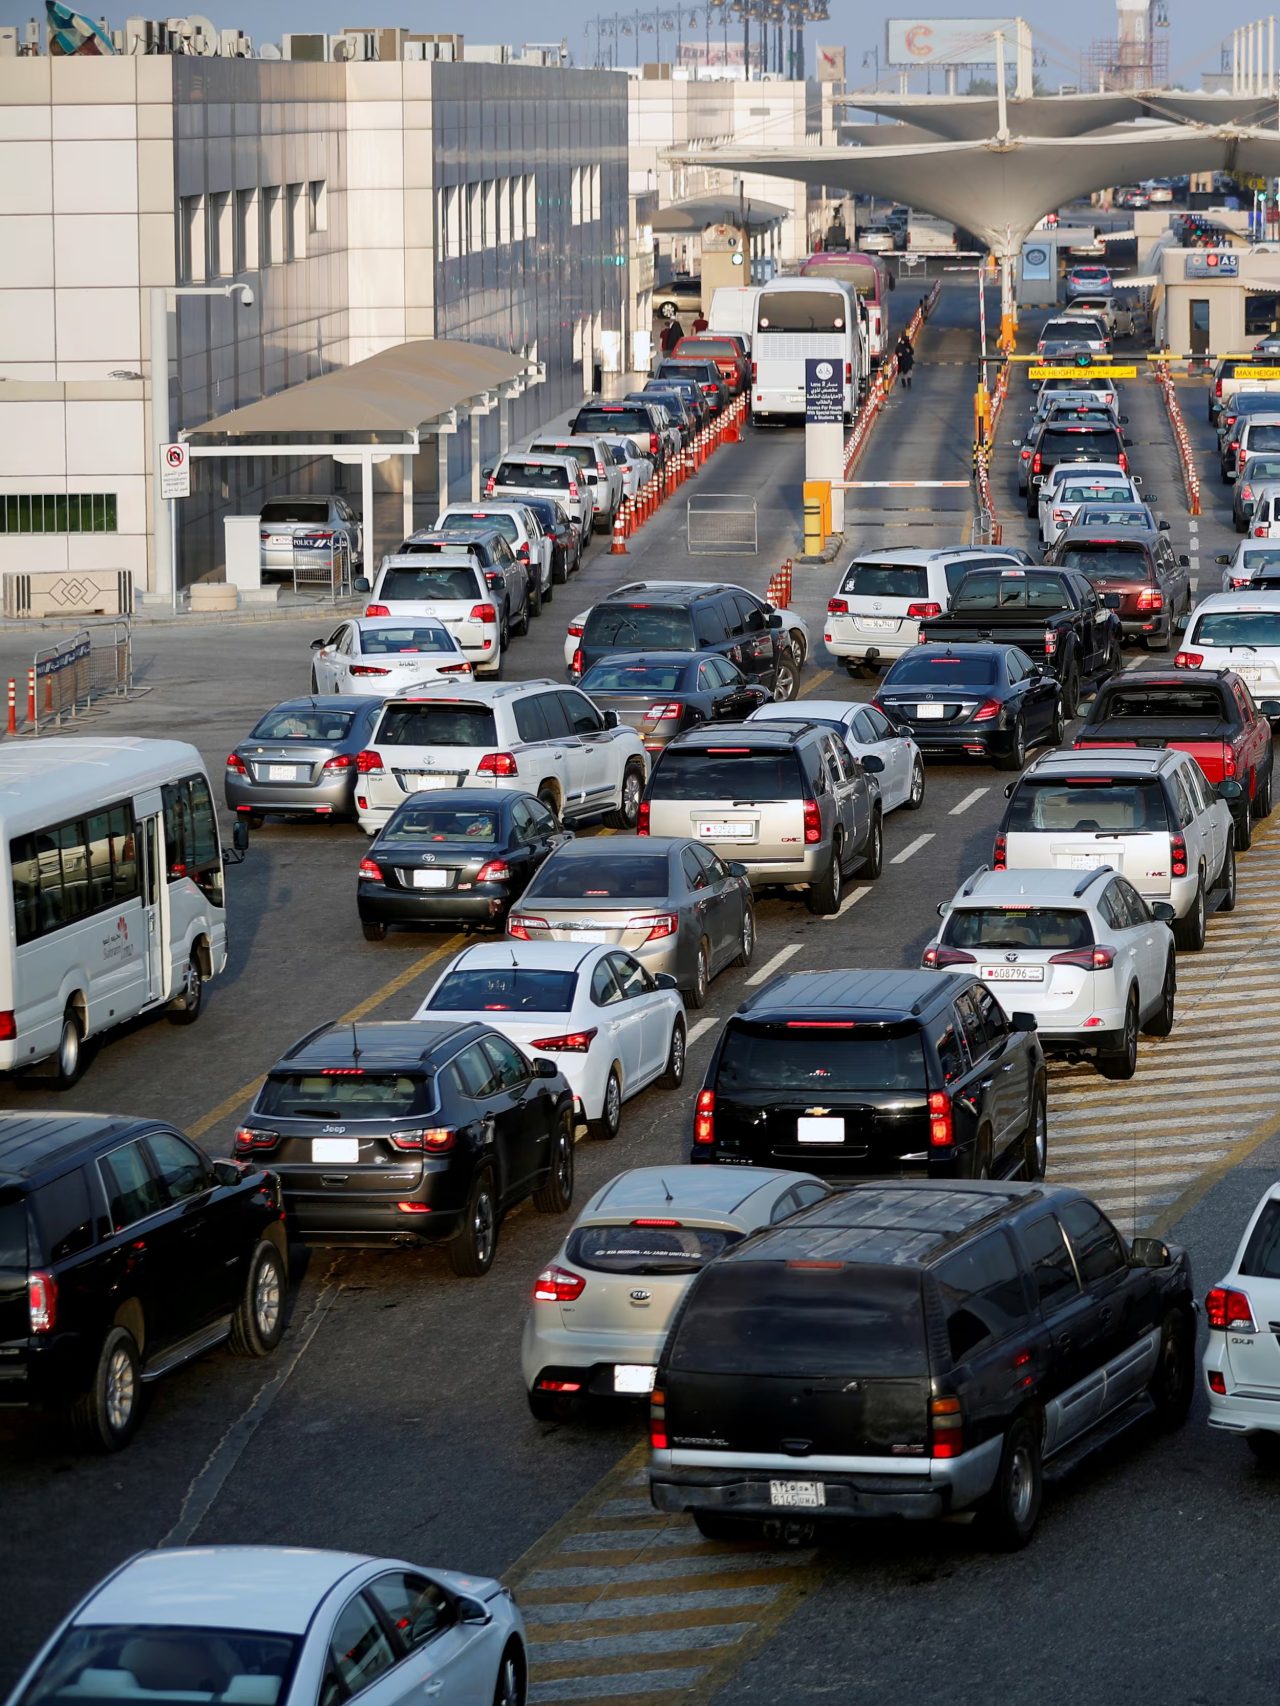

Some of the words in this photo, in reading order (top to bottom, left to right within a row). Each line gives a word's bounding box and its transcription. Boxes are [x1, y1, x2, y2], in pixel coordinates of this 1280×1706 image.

[1221, 255, 1236, 265] A5
[1236, 368, 1251, 376] MAX
[293, 538, 313, 546] POLICE
[994, 969, 1027, 978] 608796
[322, 1125, 346, 1134] Jeep
[773, 1494, 798, 1506] 6145
